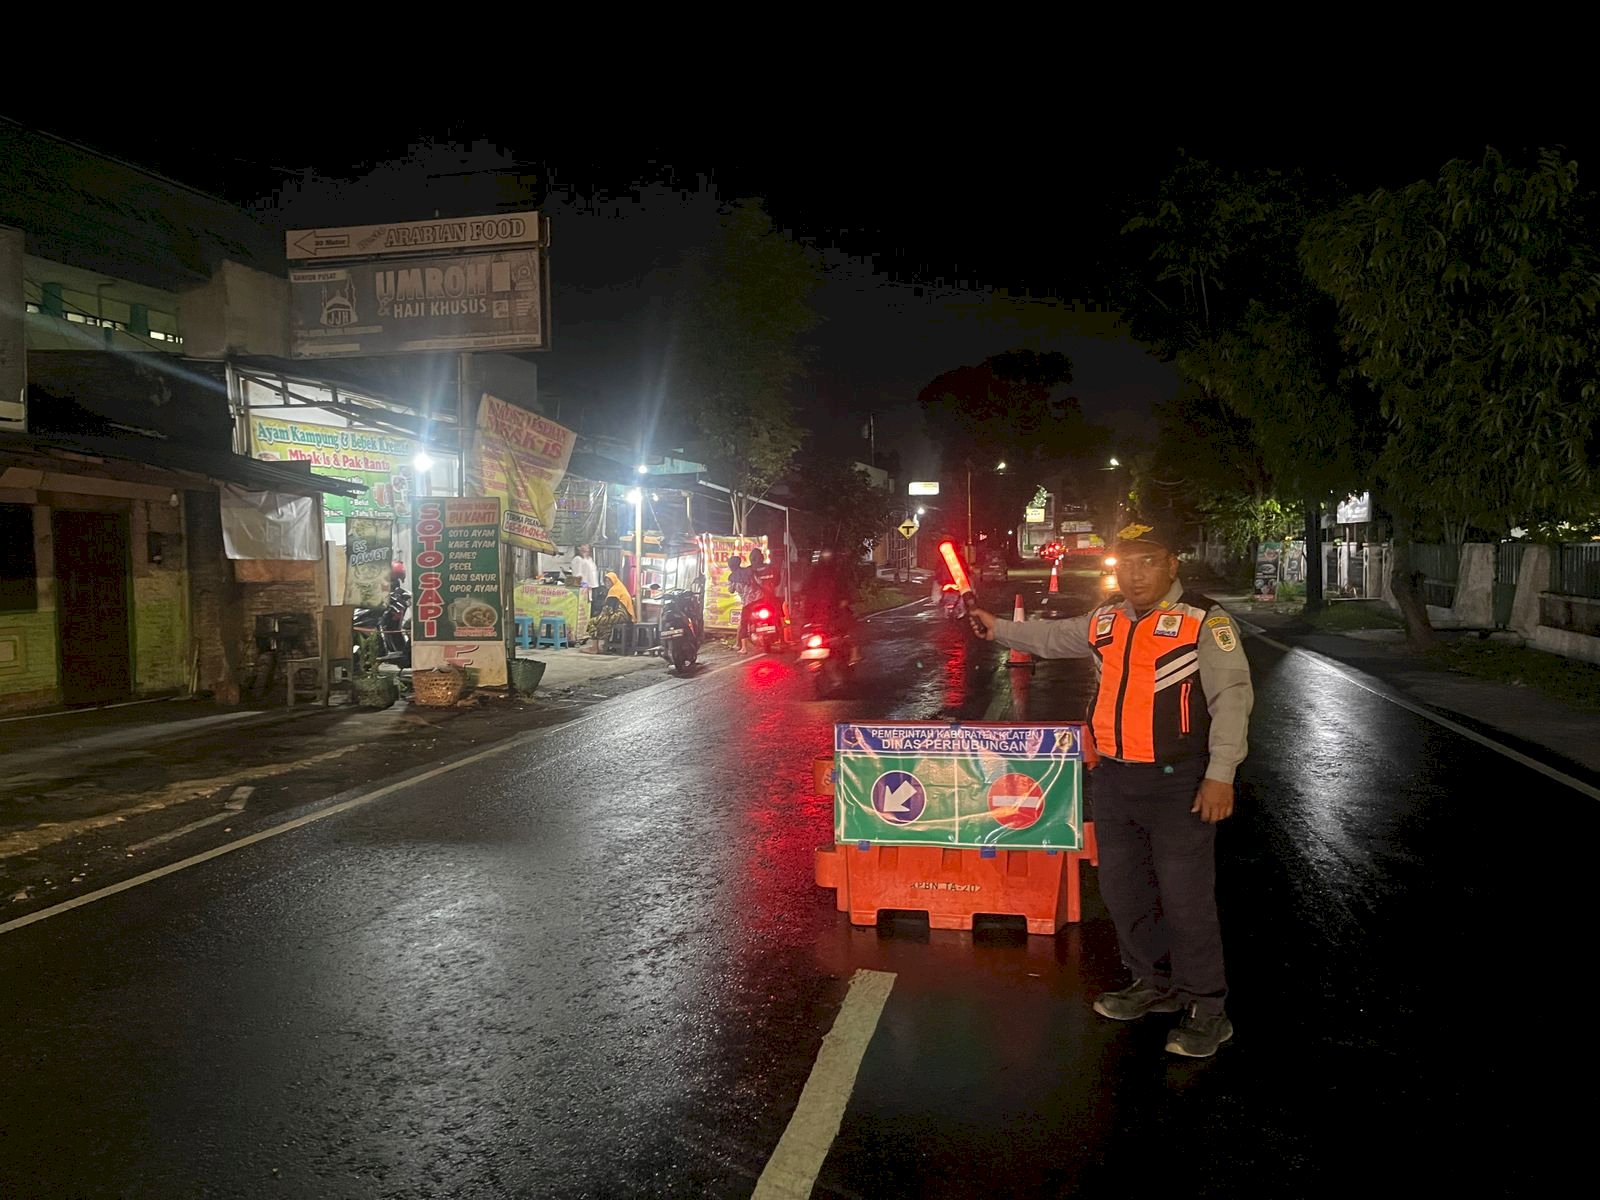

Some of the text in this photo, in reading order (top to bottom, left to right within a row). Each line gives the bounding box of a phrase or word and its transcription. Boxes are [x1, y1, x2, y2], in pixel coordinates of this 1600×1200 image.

[384, 221, 467, 248] ARABIAN
[470, 218, 526, 240] FOOD
[374, 262, 488, 301] UMROH
[393, 302, 425, 319] HAJI
[430, 298, 487, 317] KHUSUS
[328, 310, 352, 325] JJH
[258, 423, 289, 444] Ayam
[290, 426, 339, 450] Kampung
[341, 431, 349, 449] &
[351, 434, 377, 451] Bebek
[288, 449, 322, 464] Mbak
[322, 452, 331, 466] Is
[333, 453, 341, 467] &
[342, 455, 361, 468] Pak
[416, 502, 444, 568] SOTO
[448, 529, 495, 537] SOTO AYAM
[353, 540, 367, 553] ES
[448, 540, 496, 548] KARE AYAM
[350, 547, 390, 567] DAWET
[448, 551, 477, 560] RAMES
[449, 562, 472, 571] PECEL
[449, 573, 496, 581] NASI SAYUR
[450, 584, 498, 593] OPOR AYAM
[416, 572, 445, 637] SAPI
[872, 729, 934, 739] PEMERINTAH
[882, 739, 1029, 751] DINAS PERHUBUNGAN
